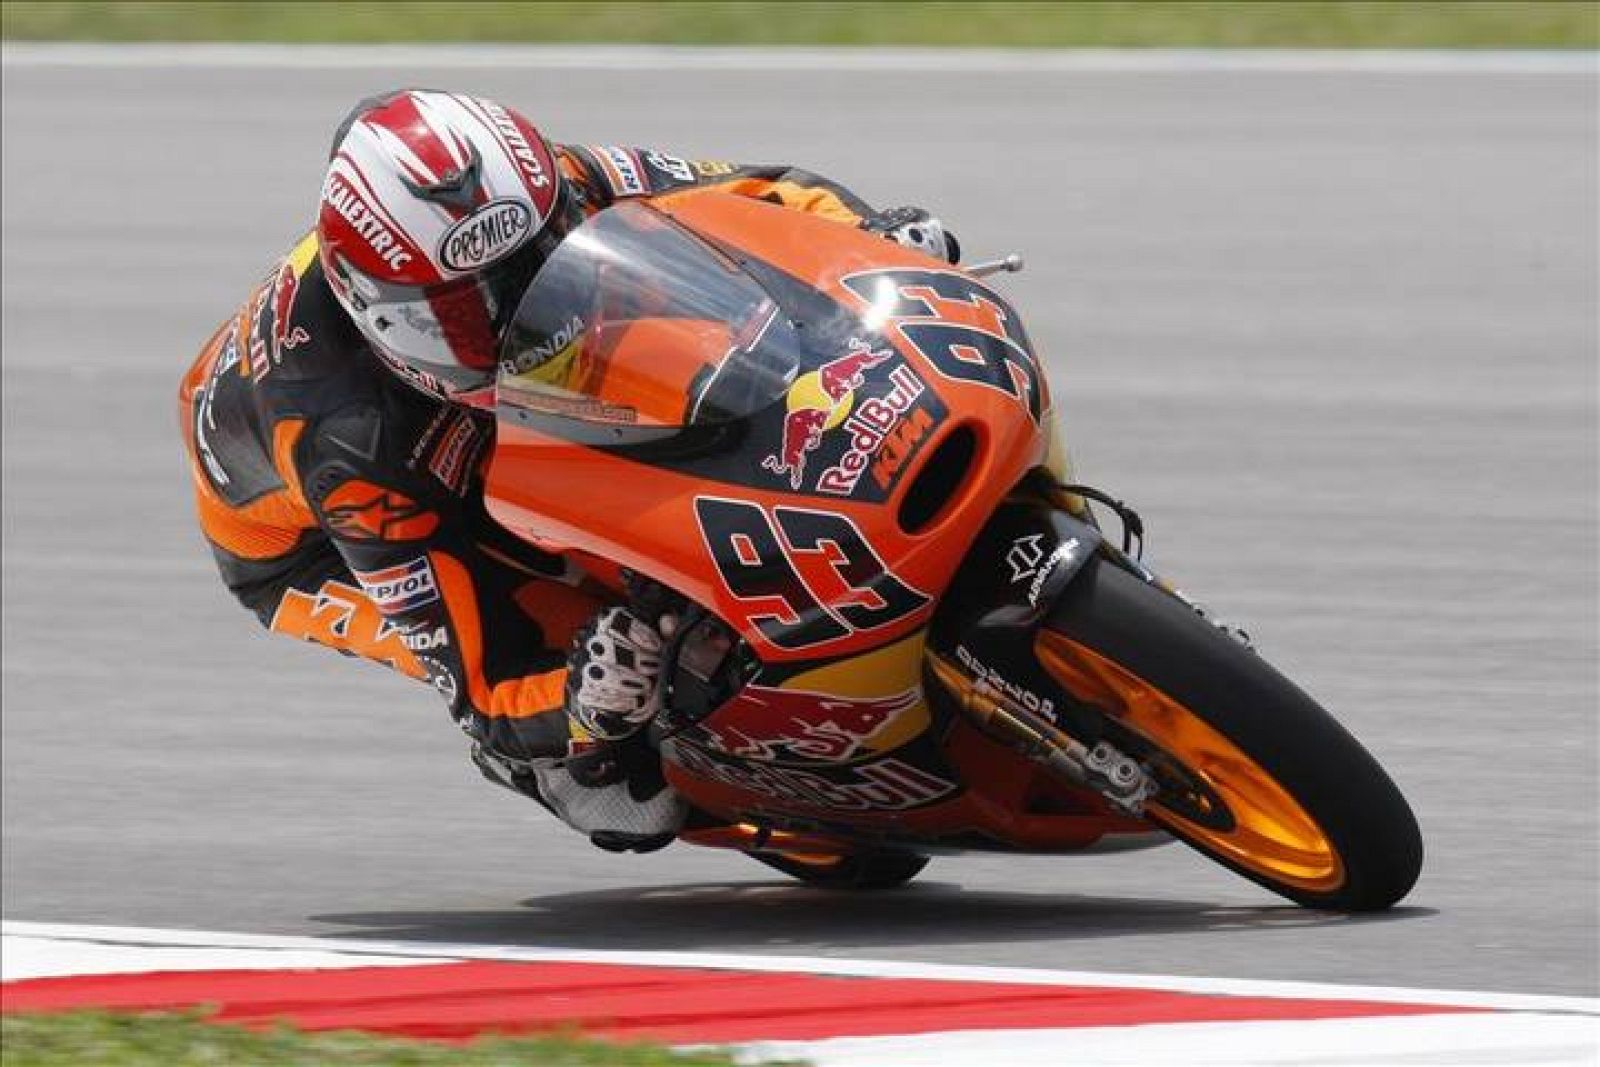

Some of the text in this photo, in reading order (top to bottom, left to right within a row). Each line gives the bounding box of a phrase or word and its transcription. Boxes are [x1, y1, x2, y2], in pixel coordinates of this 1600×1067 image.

[450, 206, 526, 266] PREMIER
[693, 496, 934, 650] 93
[956, 644, 1057, 723] DUNLOP
